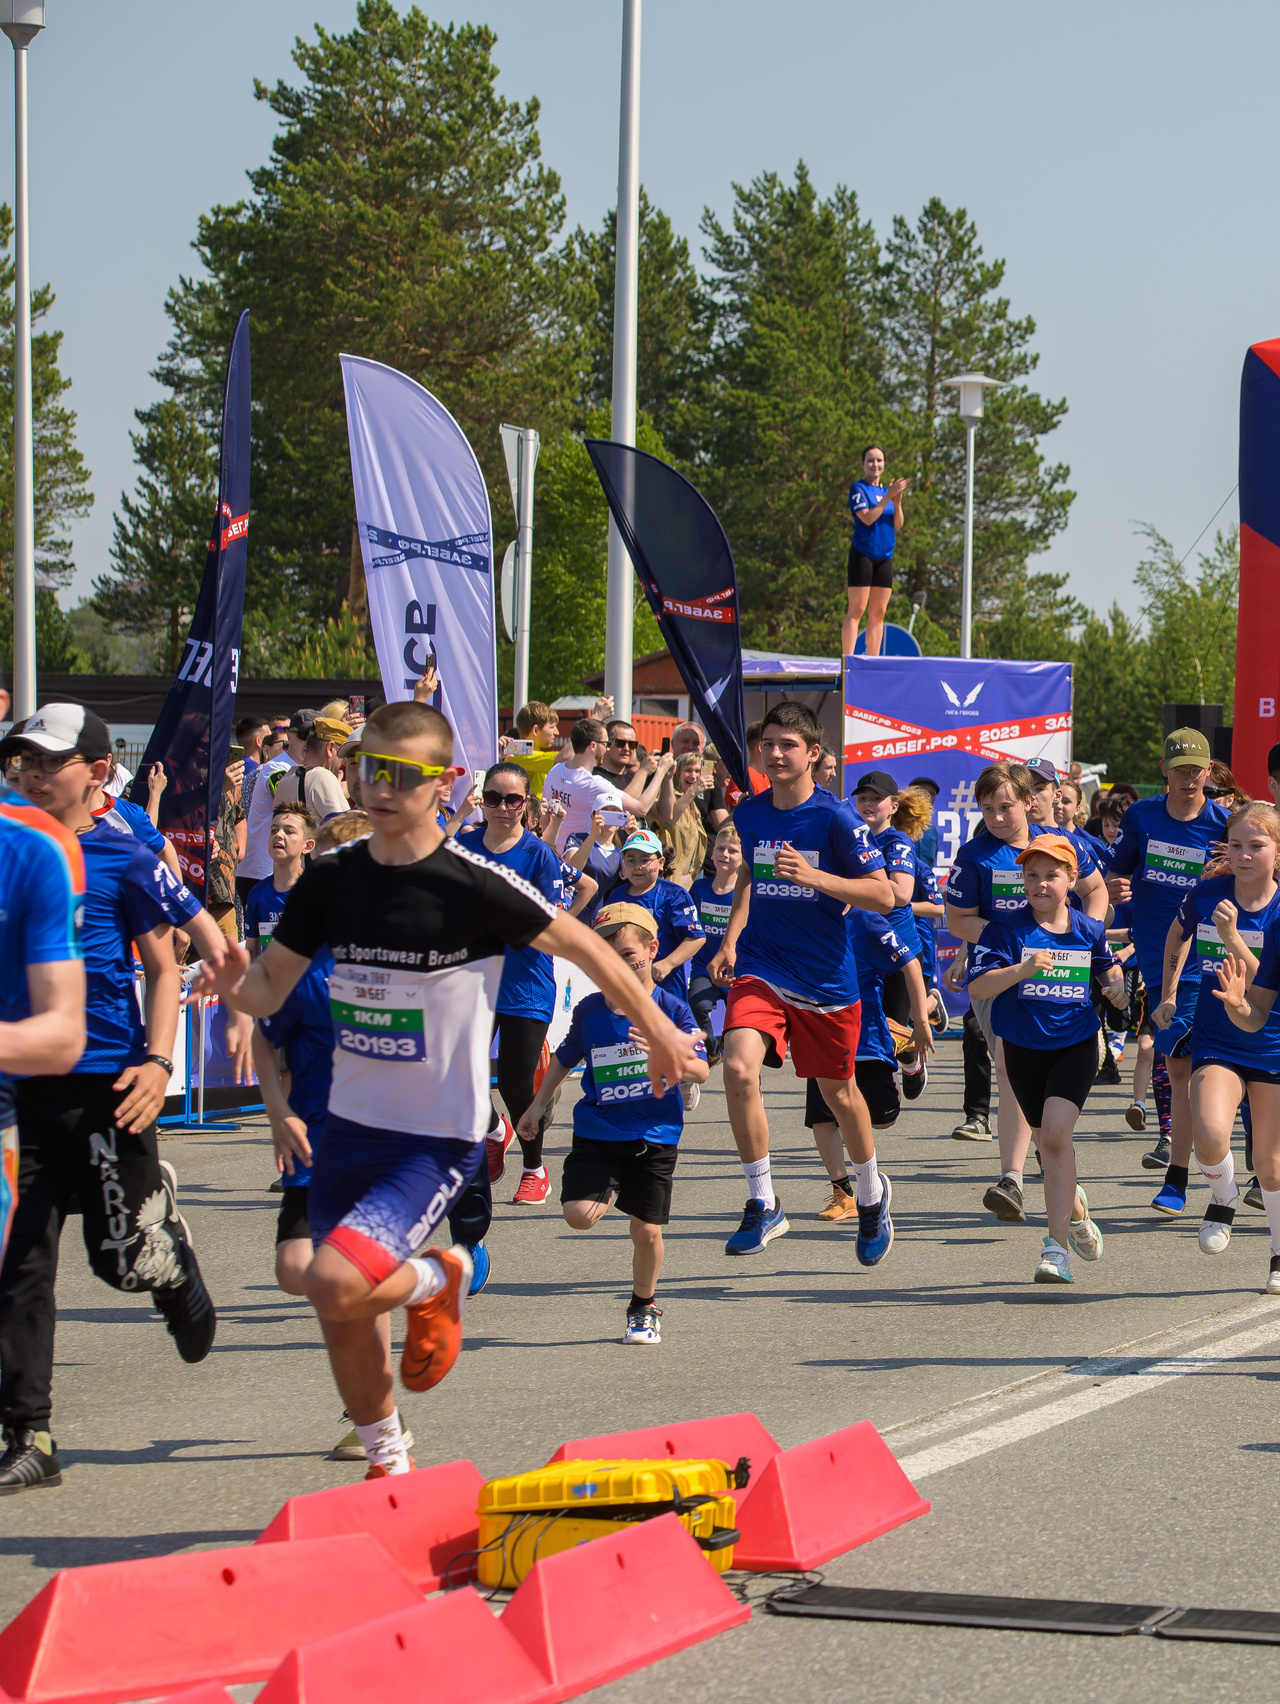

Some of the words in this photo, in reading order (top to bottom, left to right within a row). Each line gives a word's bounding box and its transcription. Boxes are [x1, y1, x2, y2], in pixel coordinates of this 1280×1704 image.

[960, 709, 980, 717] ГЕРОЕВ
[1259, 698, 1275, 718] В
[852, 710, 892, 726] ЗАБЕГ.РФ
[900, 724, 922, 736] 2023
[871, 734, 958, 758] ЗАБЕГ.РФ
[979, 725, 1020, 743] 2023
[1170, 743, 1202, 751] YAMAL
[980, 748, 1000, 759] 2023
[853, 824, 870, 848] 7
[895, 844, 911, 858] 7
[1166, 845, 1186, 856] ЗАБЕГ
[1163, 859, 1187, 870] 1KM
[1146, 869, 1198, 888] 20484
[757, 882, 816, 898] 20399
[1011, 886, 1025, 894] 1K
[995, 899, 1028, 910] 204
[348, 943, 424, 964] Sportswear
[428, 947, 469, 967] Brand
[1042, 969, 1071, 978] 1KM
[354, 987, 387, 1000] ЗАБЕГ
[1023, 983, 1085, 999] 20452
[353, 1010, 392, 1026] 1KM
[340, 1029, 418, 1057] 20193
